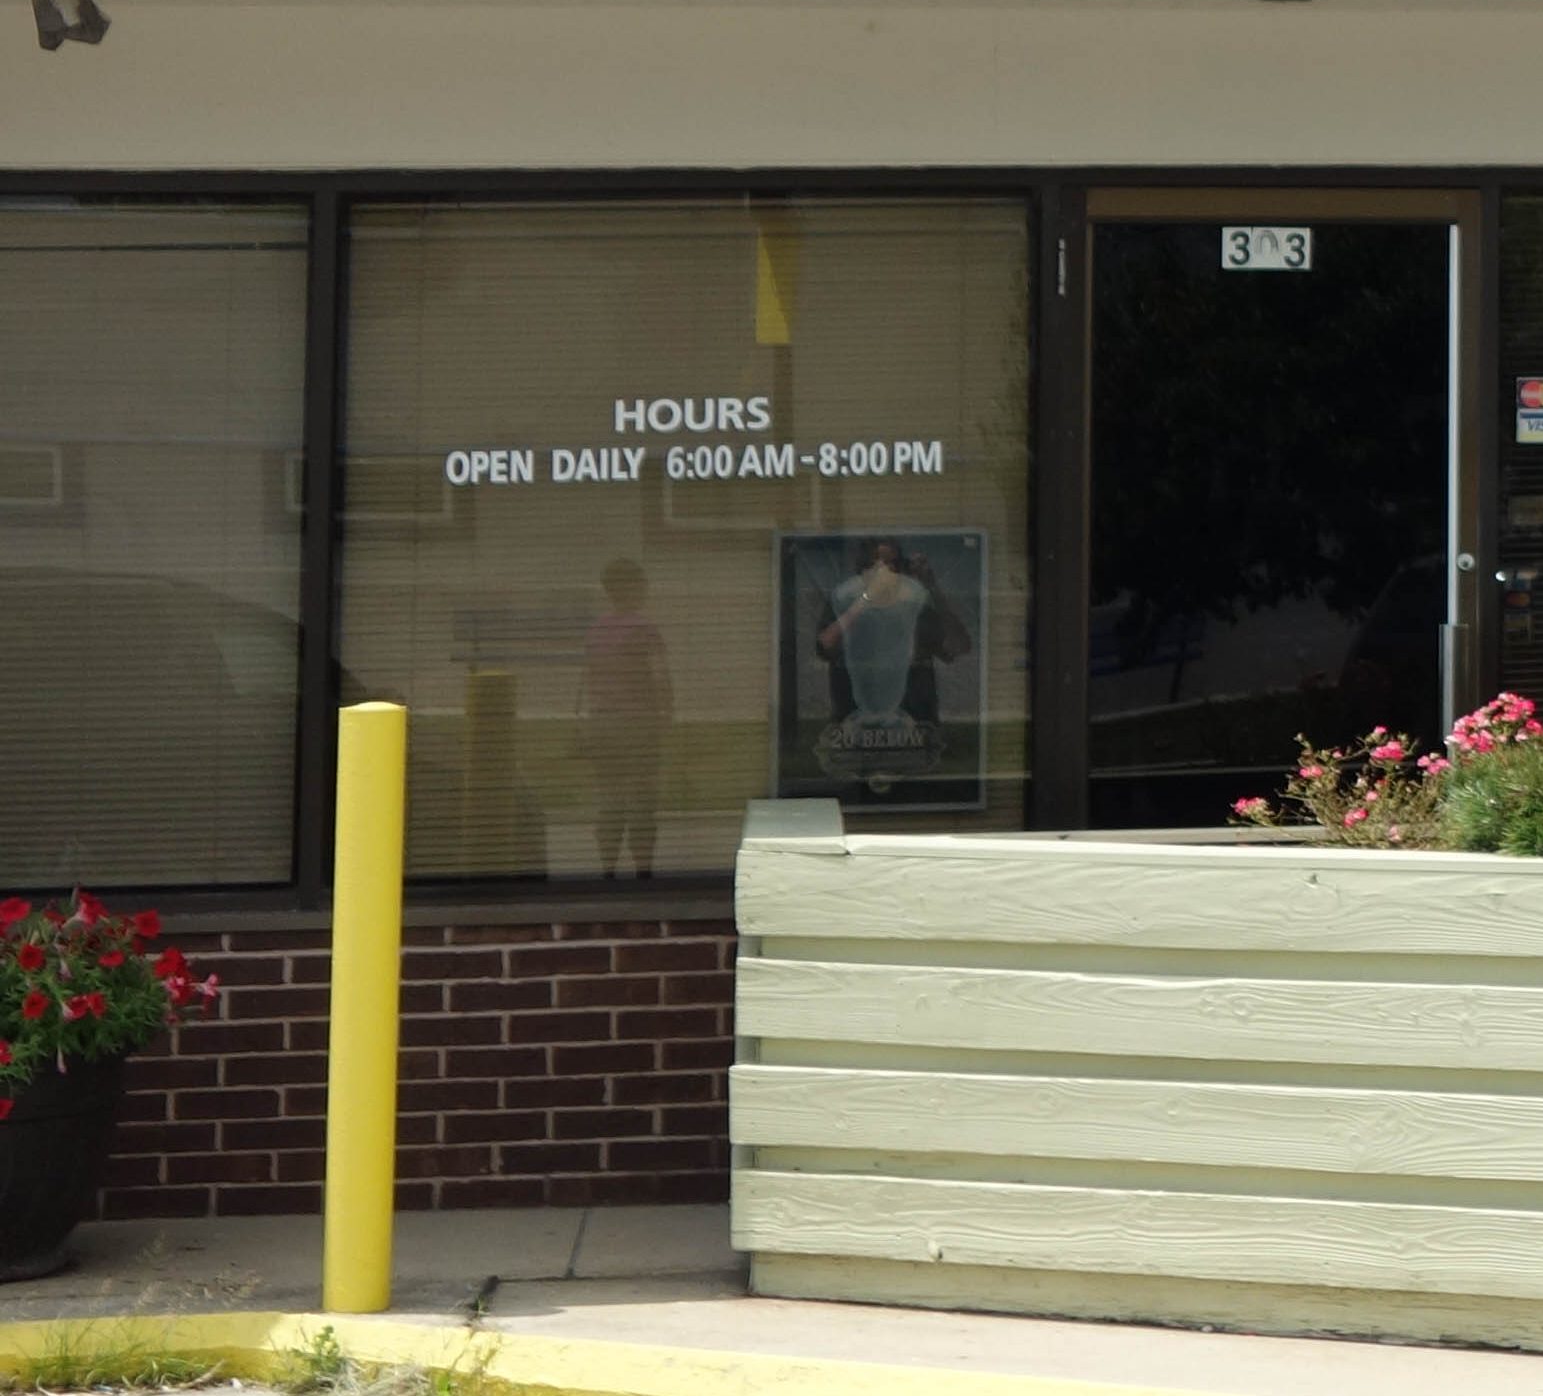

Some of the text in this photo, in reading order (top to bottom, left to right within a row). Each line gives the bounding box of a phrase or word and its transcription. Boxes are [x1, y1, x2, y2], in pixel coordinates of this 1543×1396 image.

[615, 396, 771, 433] HOURS
[446, 449, 535, 484] OPEN
[552, 446, 646, 482] DAILY
